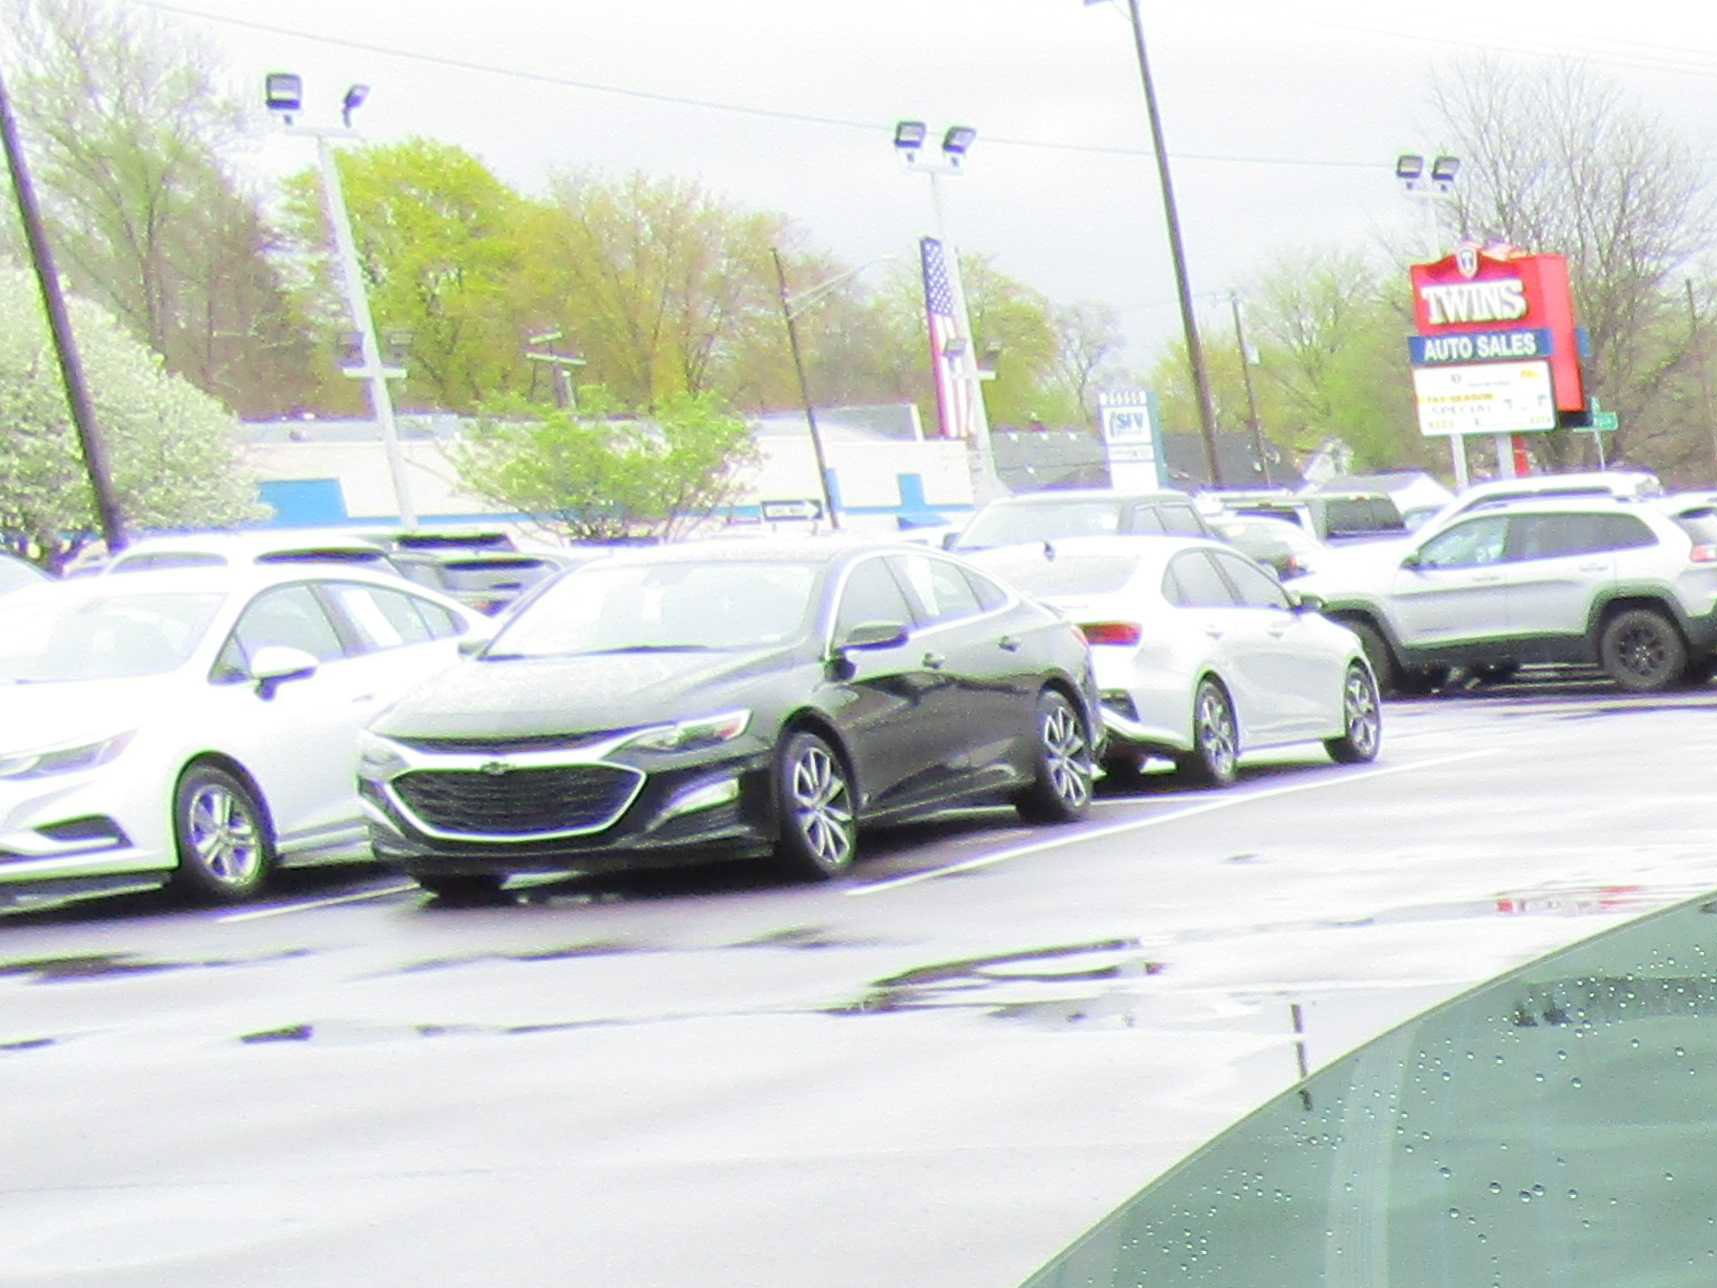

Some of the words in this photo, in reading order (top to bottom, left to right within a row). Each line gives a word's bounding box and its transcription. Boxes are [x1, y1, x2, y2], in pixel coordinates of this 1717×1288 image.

[1420, 278, 1527, 325] TWINS
[1424, 337, 1473, 361] AUTO
[1476, 332, 1537, 357] SALES
